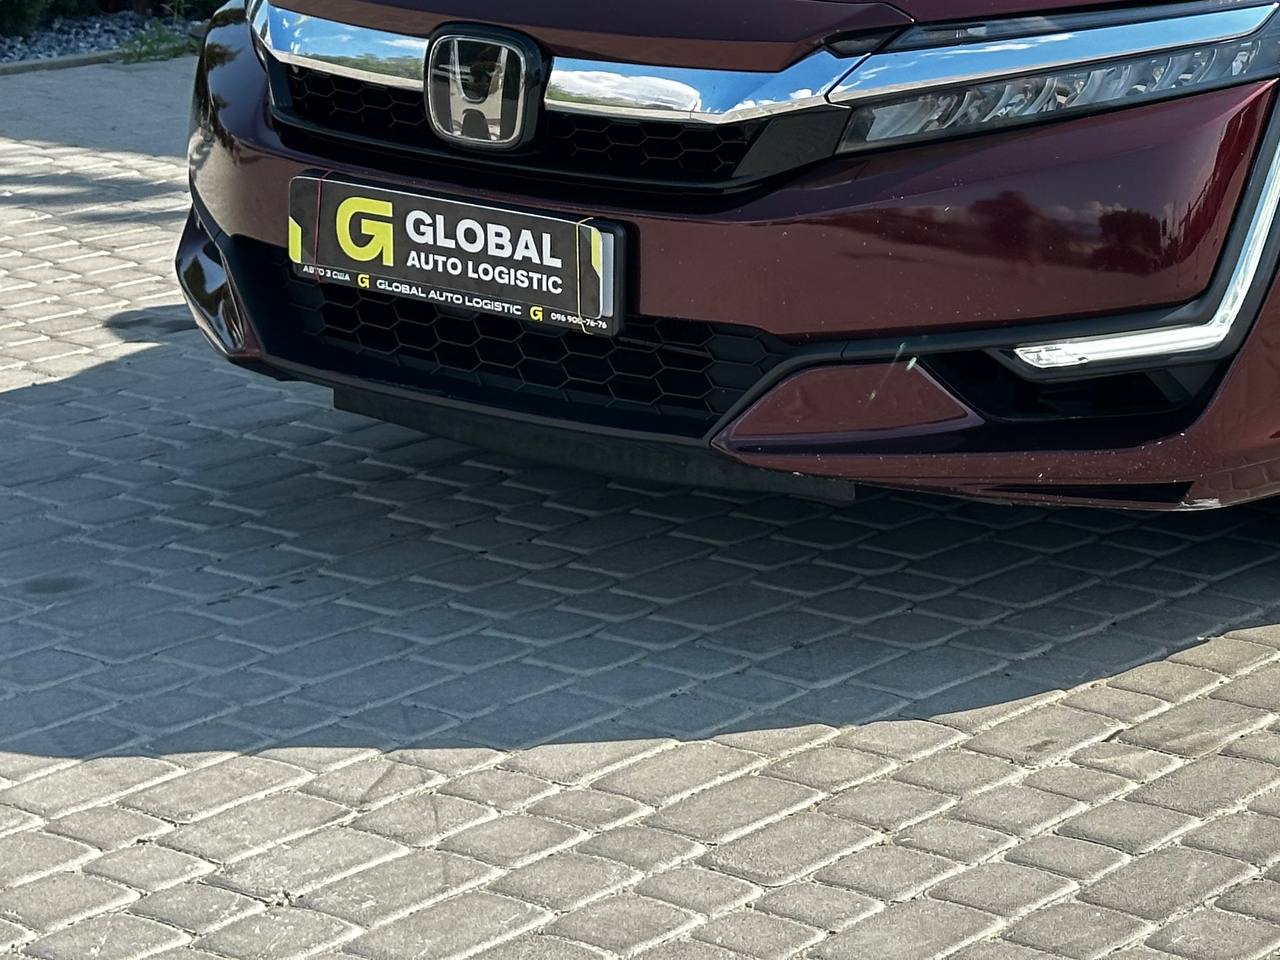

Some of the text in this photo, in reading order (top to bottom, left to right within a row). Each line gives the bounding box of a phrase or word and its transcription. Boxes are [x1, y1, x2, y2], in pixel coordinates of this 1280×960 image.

[405, 210, 563, 268] GLOBAL
[406, 250, 563, 294] AUTO LOGISTIC
[376, 279, 426, 298] GLOBAL
[428, 289, 463, 304] AUTO
[465, 296, 522, 315] LOGISTIC
